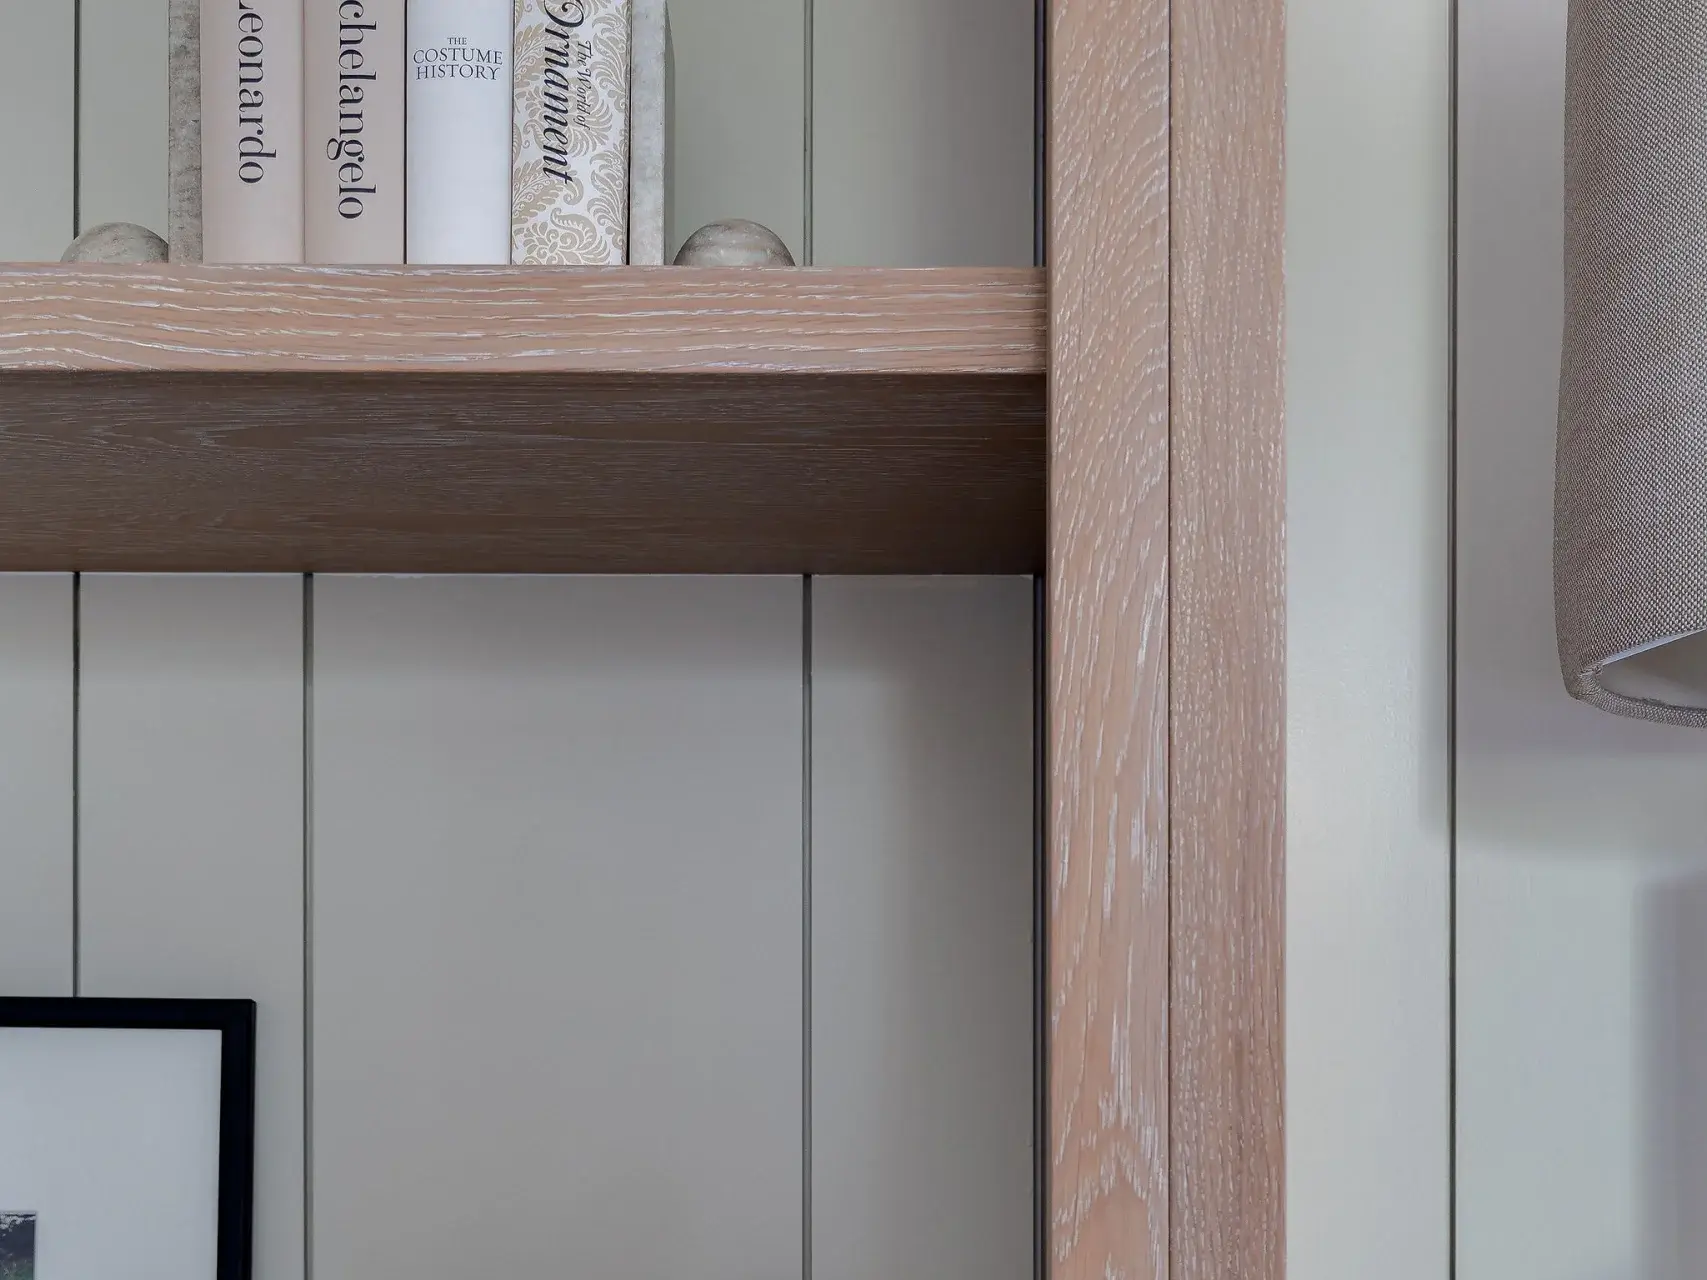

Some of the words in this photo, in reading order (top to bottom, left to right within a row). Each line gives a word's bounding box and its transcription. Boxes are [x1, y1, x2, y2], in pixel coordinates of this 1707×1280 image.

[447, 37, 467, 46] THE
[413, 48, 503, 65] COSTUME
[577, 41, 592, 66] The
[416, 64, 501, 81] HISTORY
[542, 0, 585, 184] Ornament
[576, 69, 592, 111] World
[573, 115, 591, 130] of
